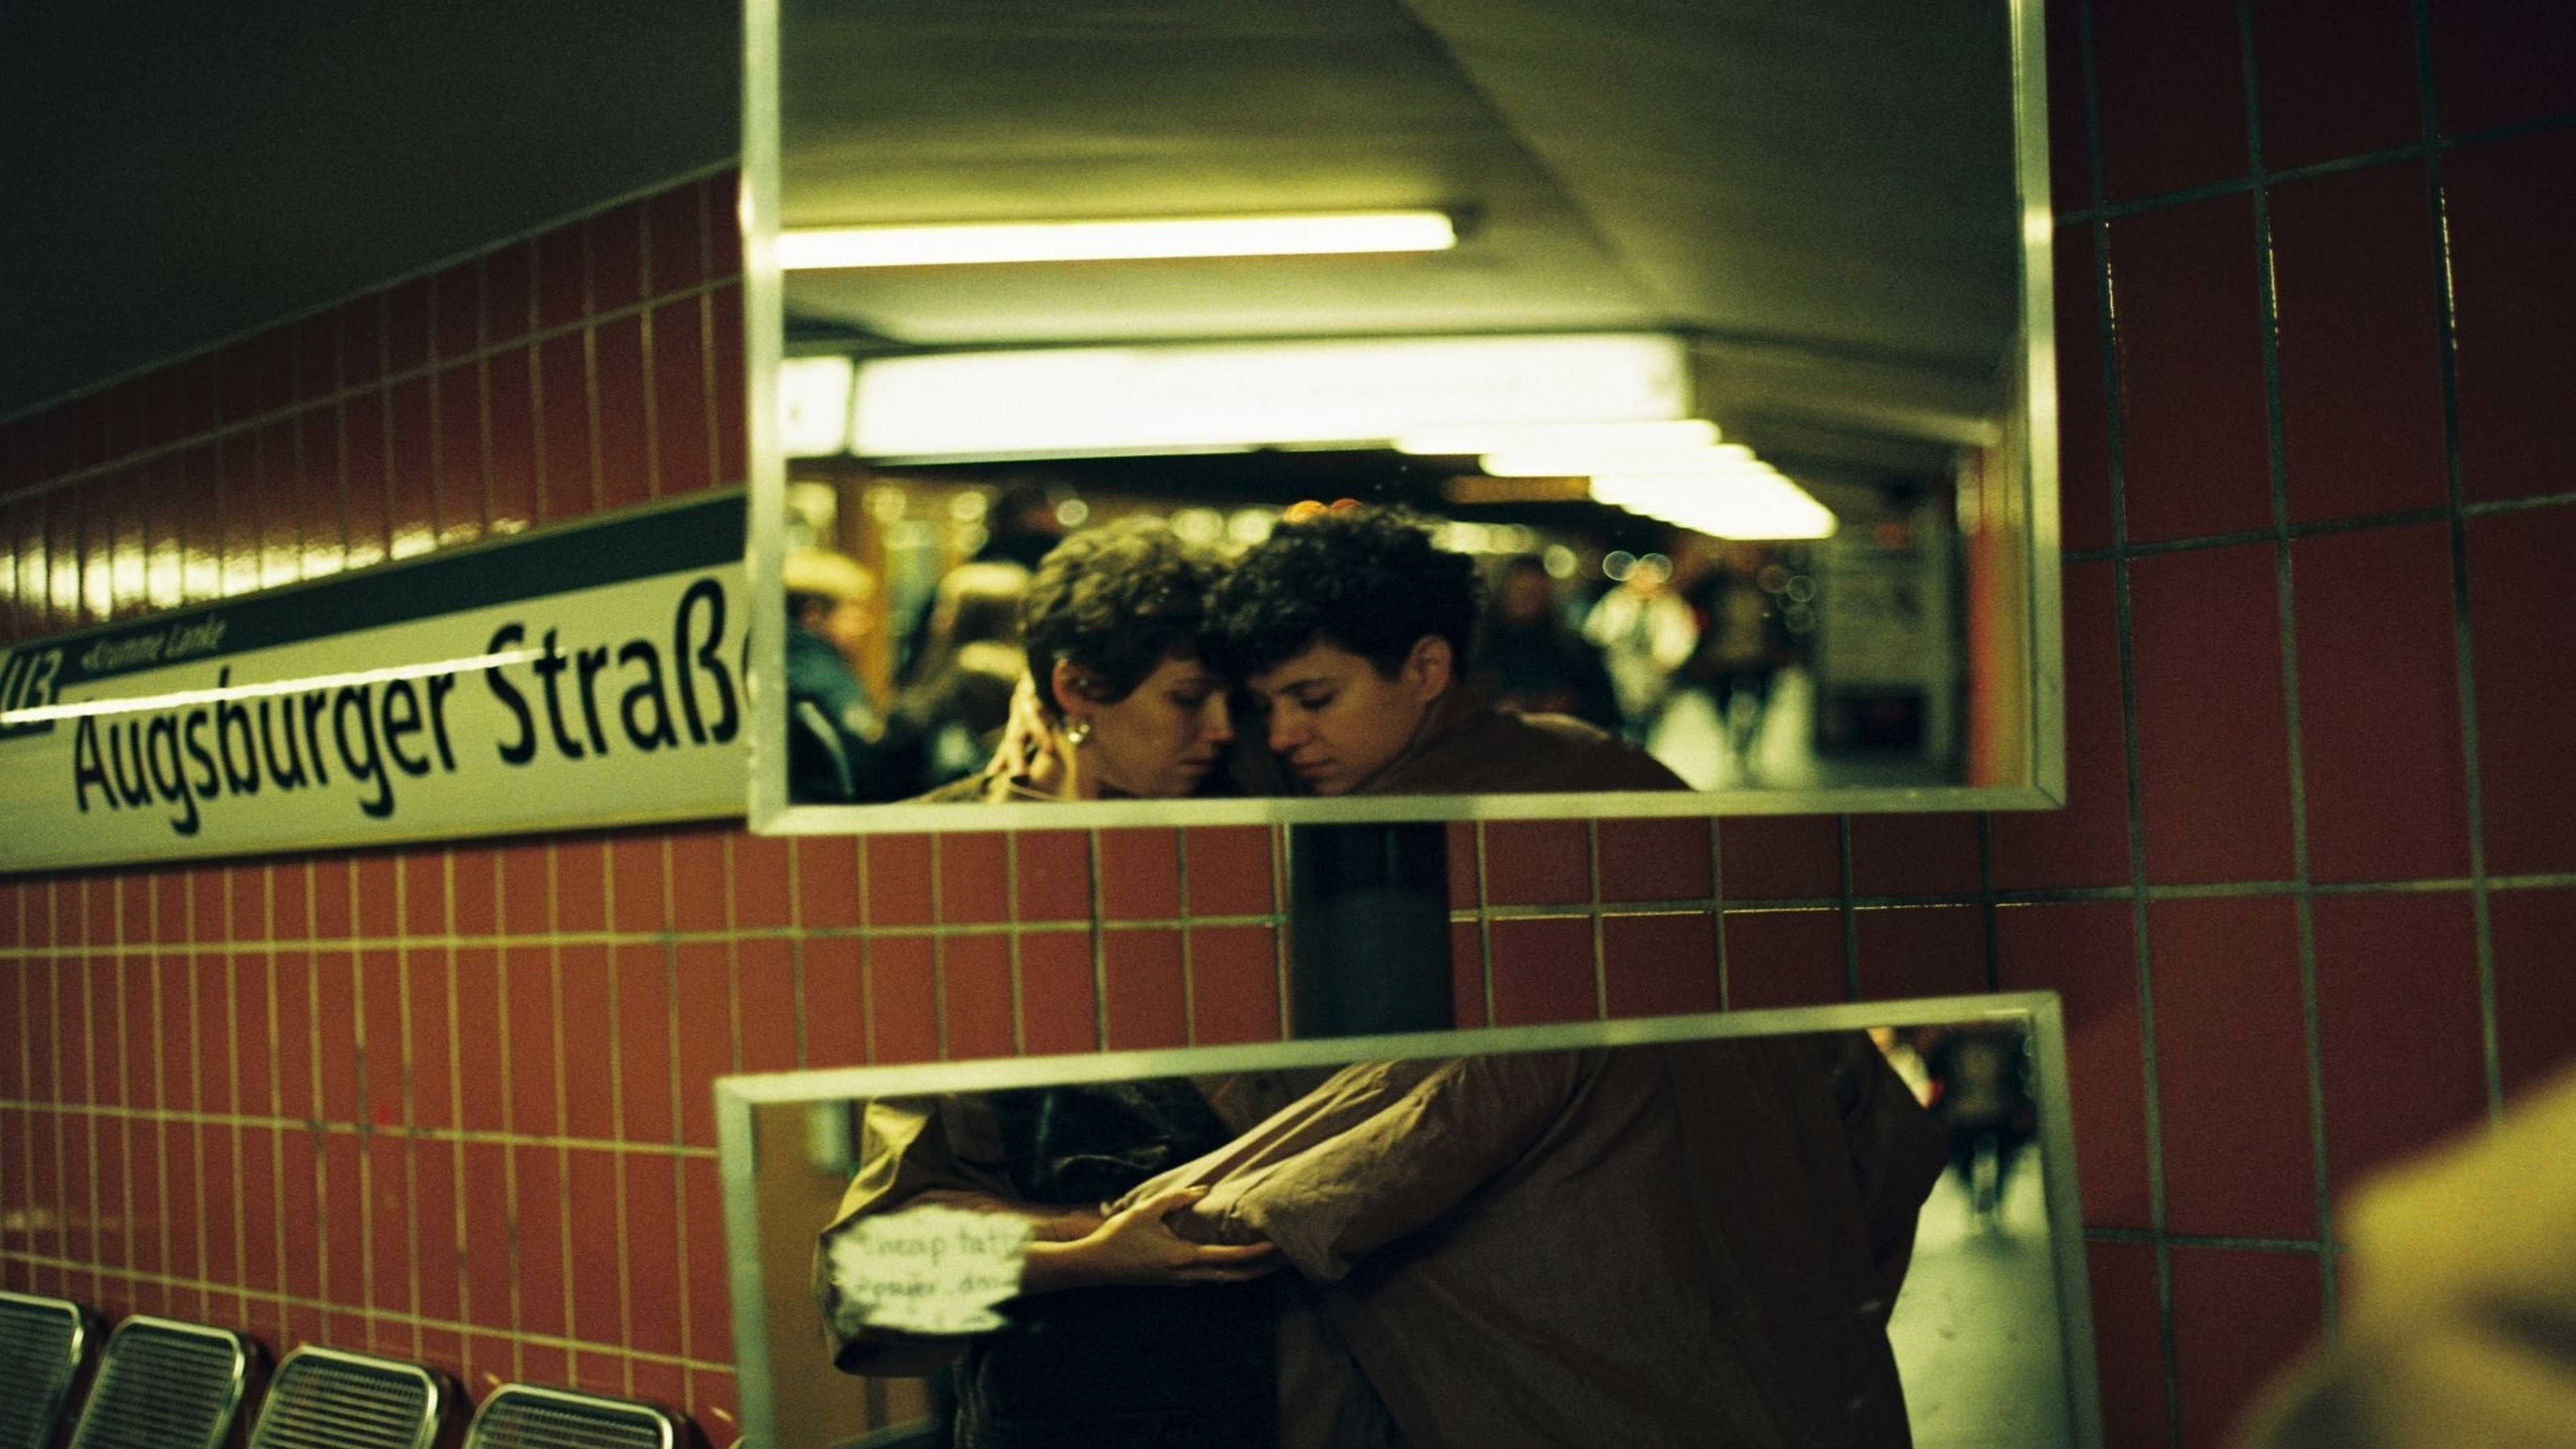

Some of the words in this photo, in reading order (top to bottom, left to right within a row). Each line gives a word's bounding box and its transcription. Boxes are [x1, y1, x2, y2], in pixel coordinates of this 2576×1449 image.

[1, 647, 63, 722] U3
[74, 665, 456, 836] Augsburger
[485, 578, 750, 765] Straß
